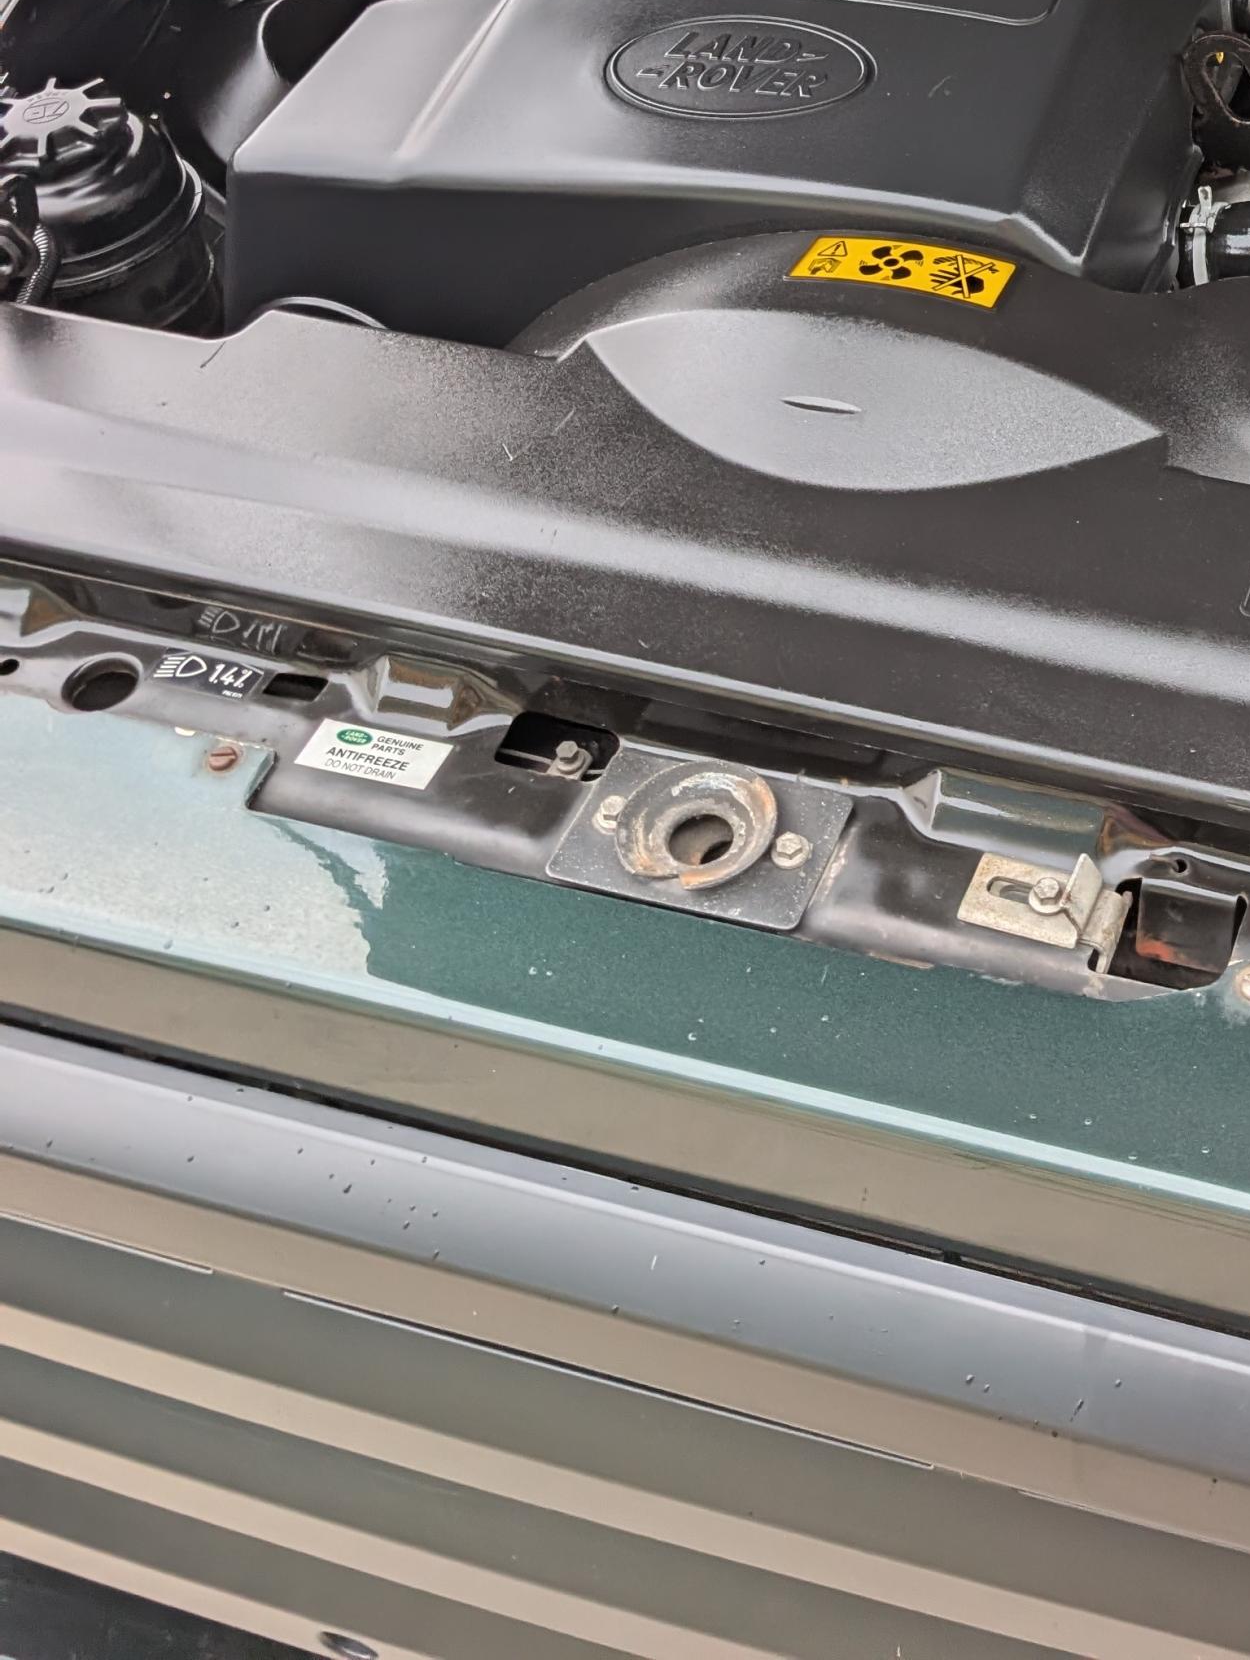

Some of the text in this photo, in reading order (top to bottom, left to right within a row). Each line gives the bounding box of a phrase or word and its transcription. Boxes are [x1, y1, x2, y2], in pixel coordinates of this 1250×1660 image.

[209, 663, 252, 688] 1.4%
[371, 743, 406, 756] PARTS
[377, 736, 424, 751] GENUINE
[325, 758, 397, 780] DO NOT DRAIN
[326, 746, 410, 771] ANTIFREEZE
